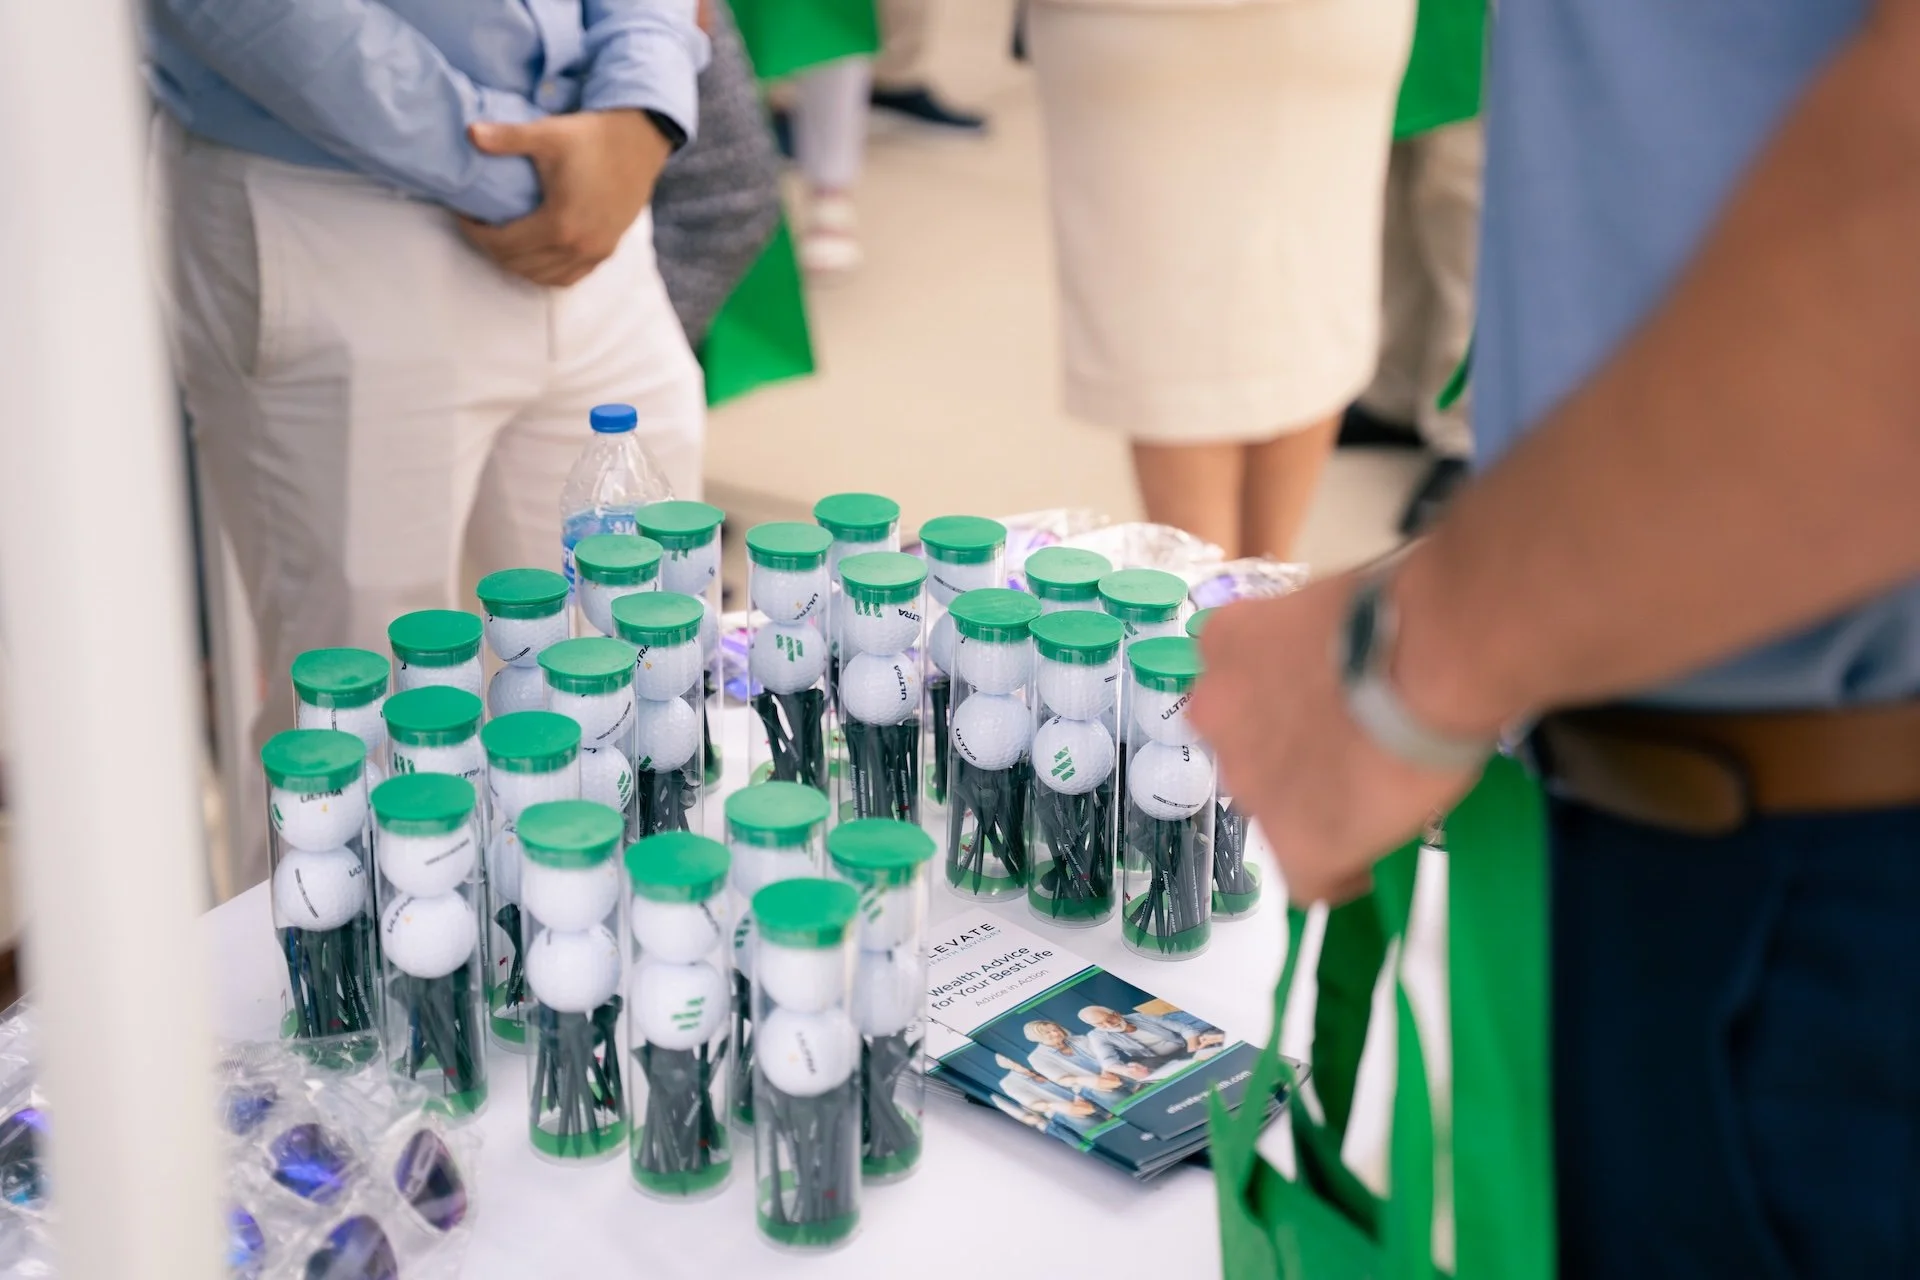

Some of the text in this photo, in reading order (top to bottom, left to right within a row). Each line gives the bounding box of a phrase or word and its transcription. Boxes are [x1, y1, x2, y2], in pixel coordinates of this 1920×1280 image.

[898, 608, 922, 622] LTRA
[893, 664, 907, 701] ULTRA
[956, 728, 977, 761] ULTRA
[928, 923, 997, 959] LEVATE
[928, 946, 1030, 998] Wealth Advice
[931, 949, 1054, 1011] for Your Best Life
[975, 968, 1049, 1008] Advice in Action
